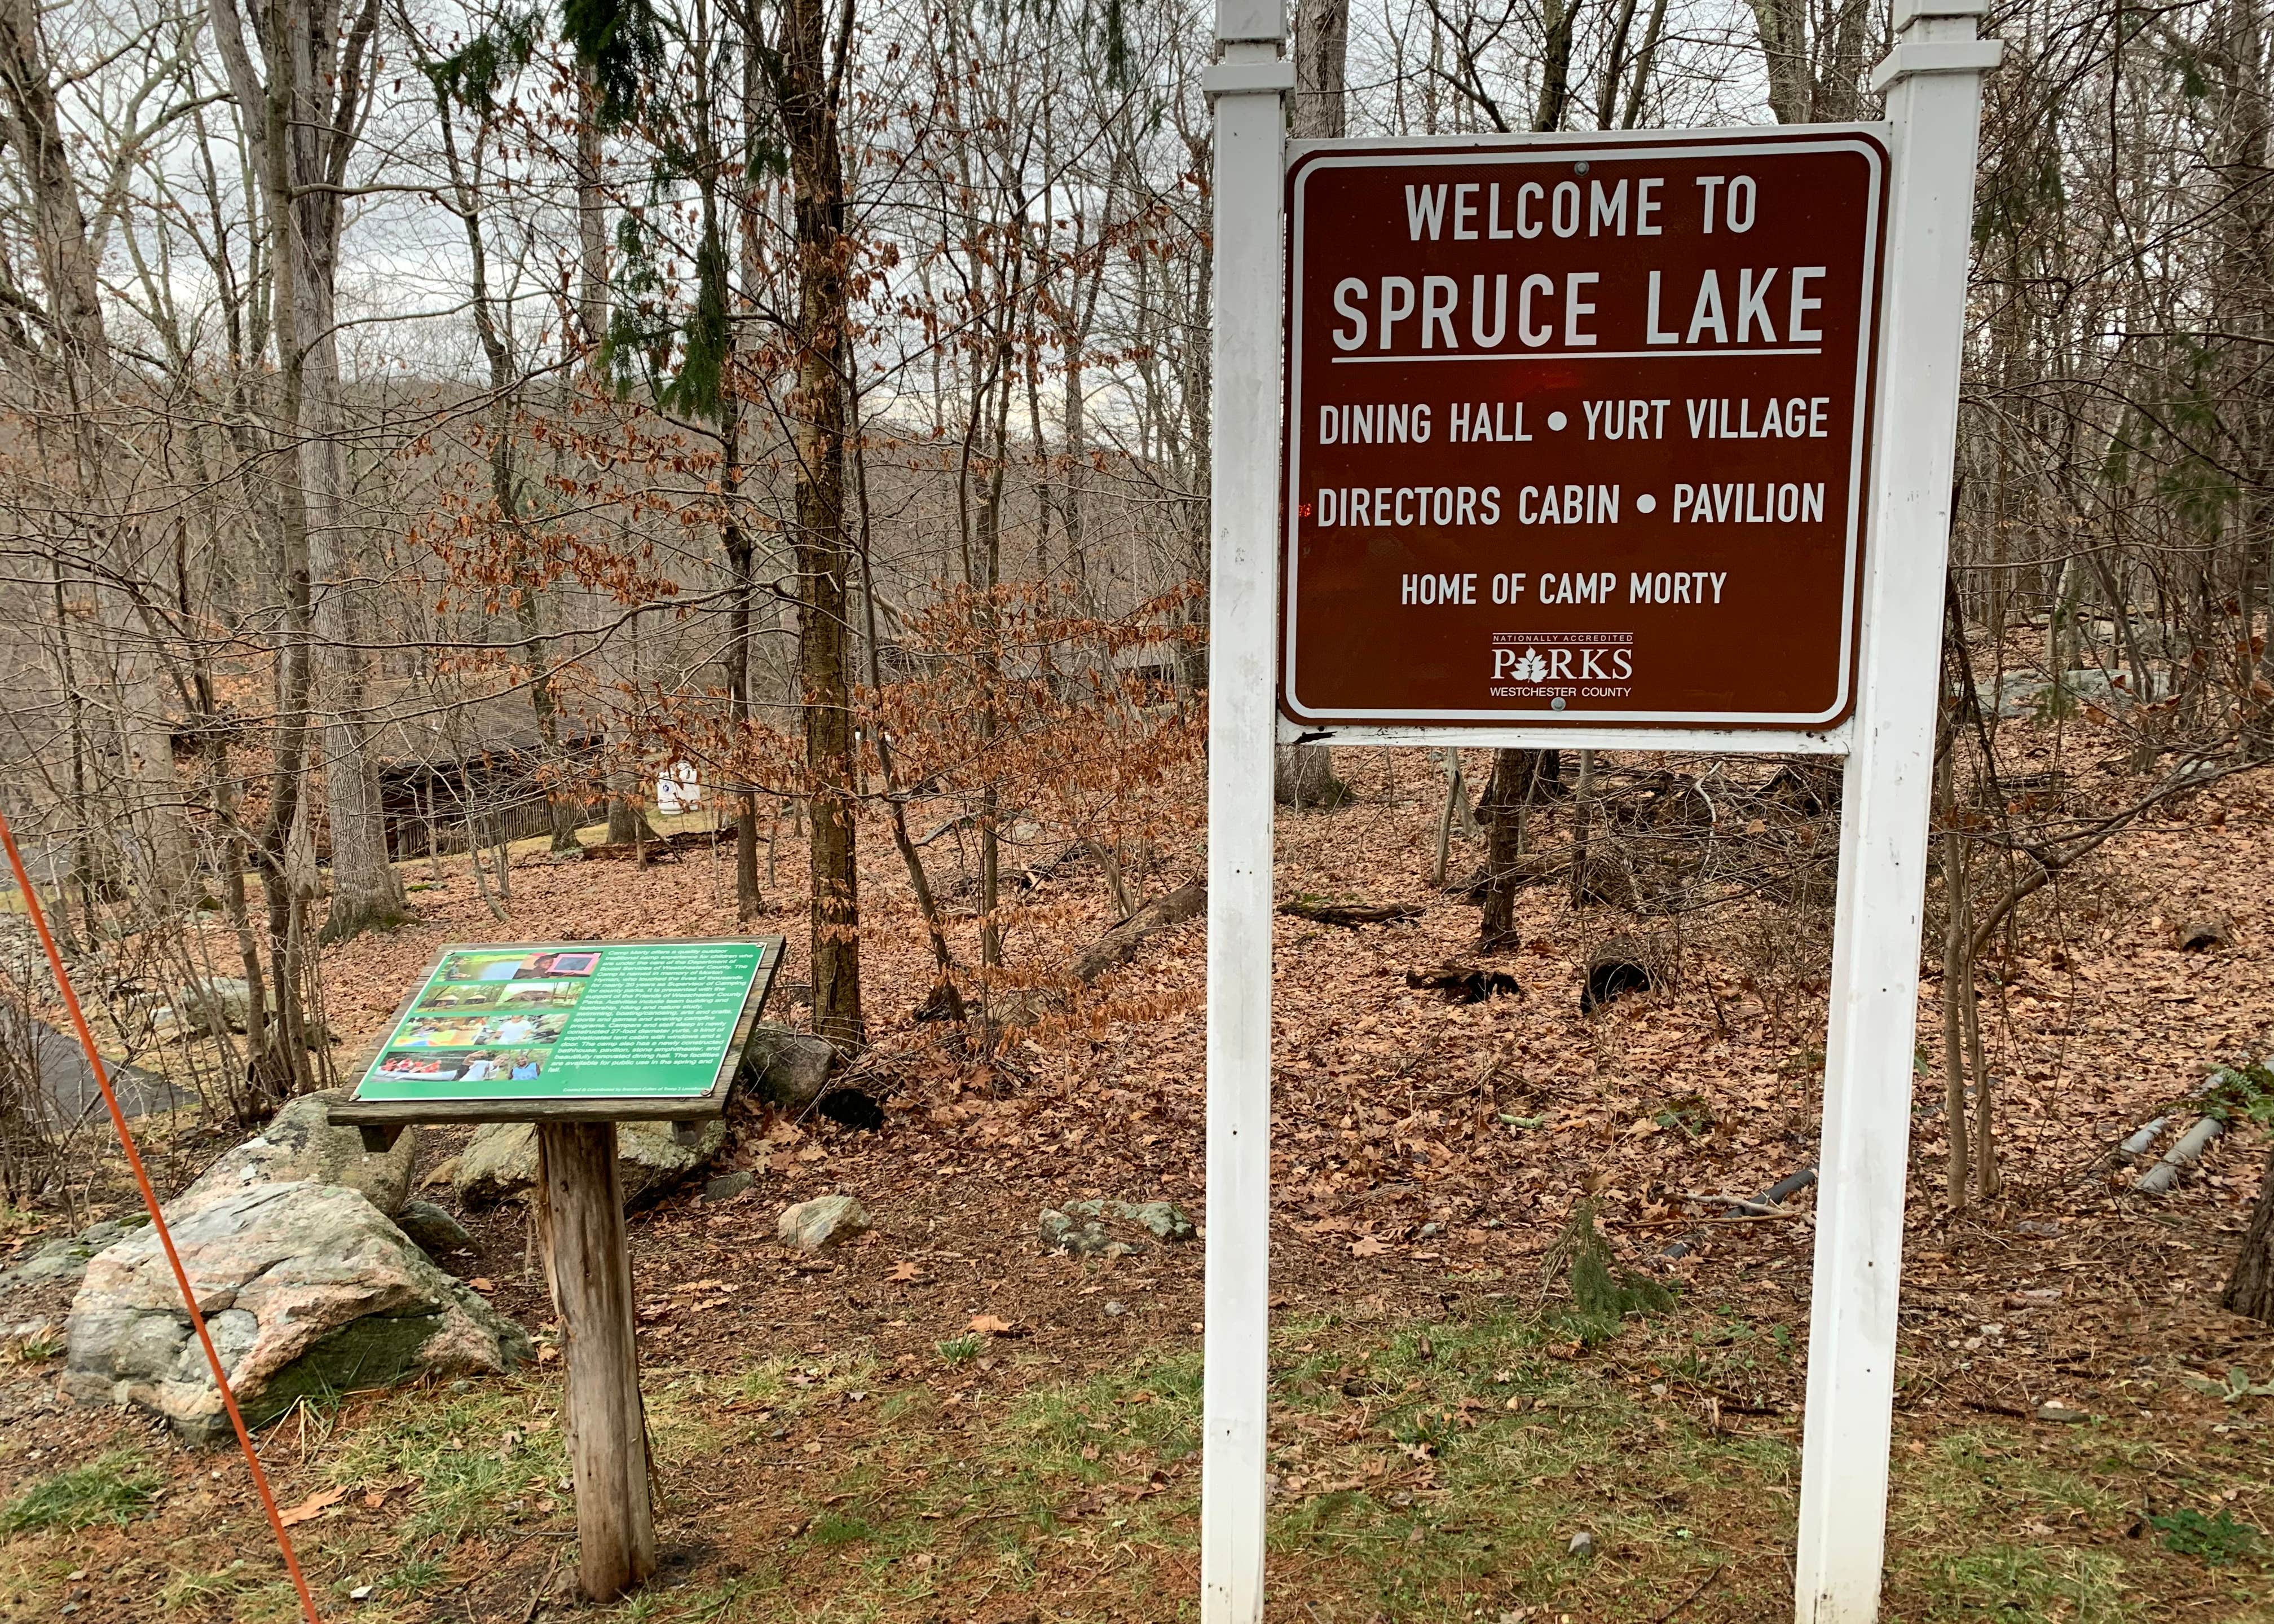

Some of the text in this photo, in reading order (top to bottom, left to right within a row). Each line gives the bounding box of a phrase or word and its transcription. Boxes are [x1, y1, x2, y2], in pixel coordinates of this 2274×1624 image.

[1405, 175, 1756, 241] WELCOME TO
[1332, 266, 1827, 351] SPRUCE LAKE
[1320, 398, 1829, 444] DINING HALL YURT VILLAGE
[1319, 483, 1824, 526] DIRECTORS CABIN PAVILION
[1403, 572, 1726, 604] HOME OF CAMP MORTY
[1491, 646, 1633, 683] PRKS
[1489, 687, 1631, 697] WESTCHESTER COUNTY
